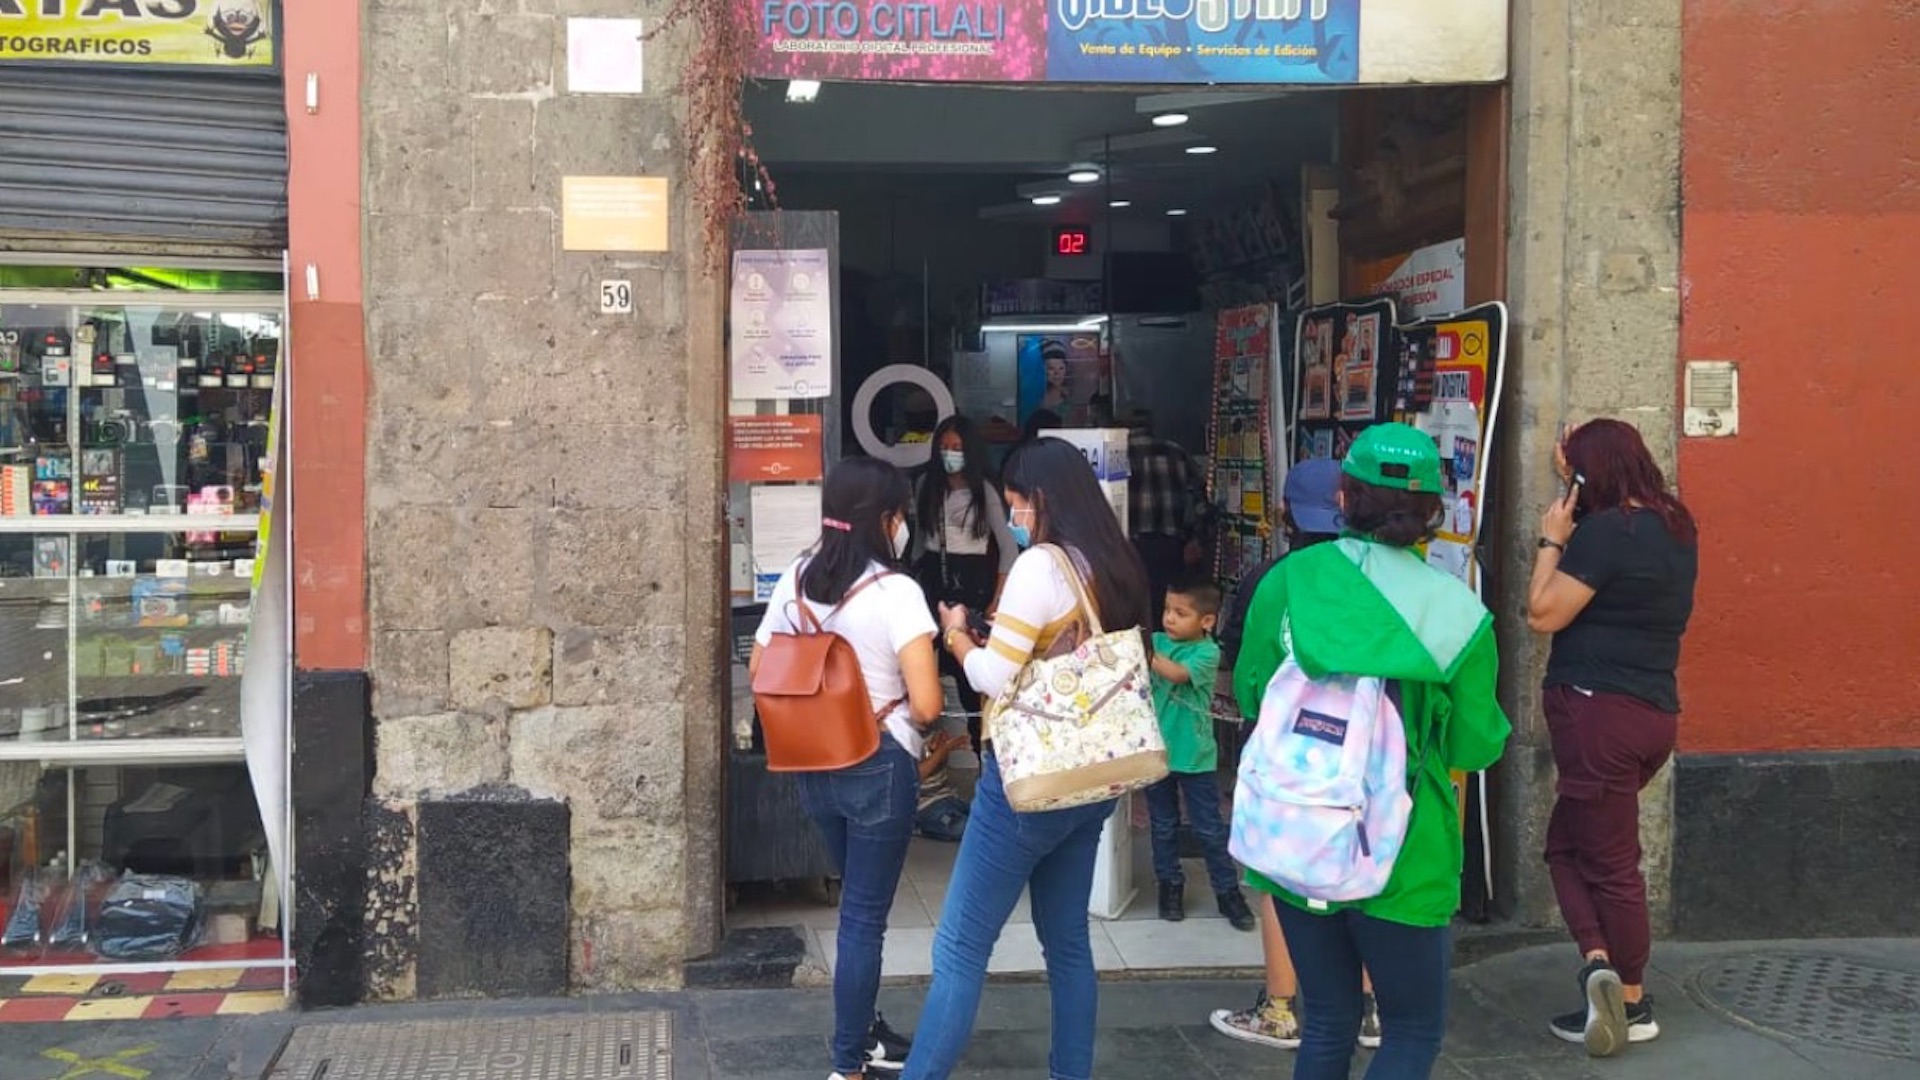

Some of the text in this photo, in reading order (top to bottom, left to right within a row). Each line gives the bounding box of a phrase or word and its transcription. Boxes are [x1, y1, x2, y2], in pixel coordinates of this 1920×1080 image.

[763, 1, 1005, 39] FOTO CITLALI
[773, 39, 860, 53] LABORATORIO
[862, 41, 909, 54] DIGITAL
[1080, 43, 1317, 58] Venta de Equipo Servicios de Edición
[1059, 233, 1084, 253] 02
[602, 285, 630, 307] 59
